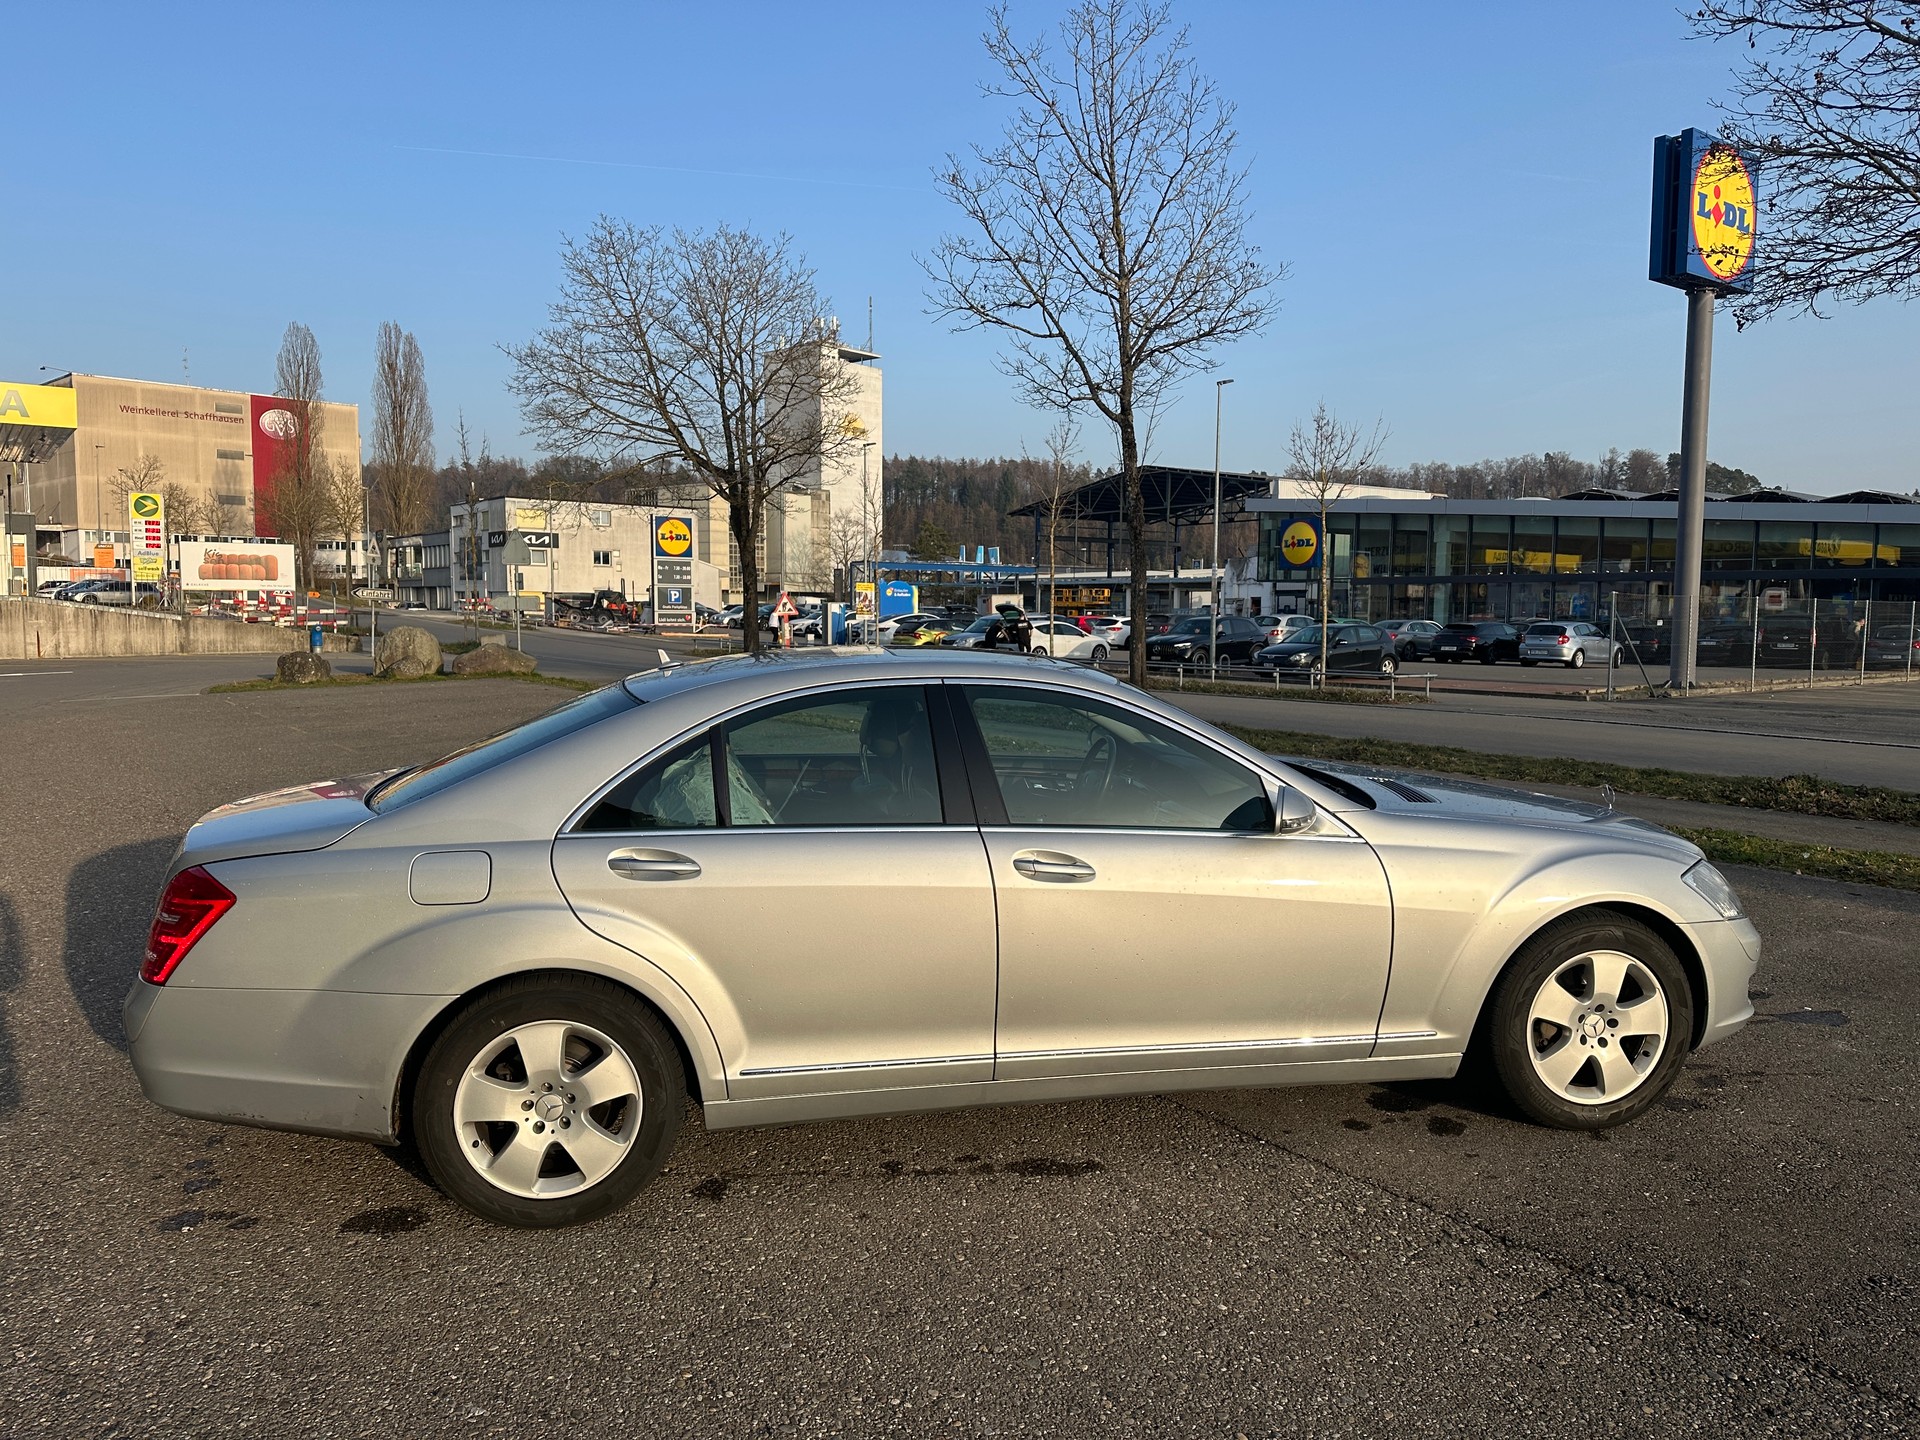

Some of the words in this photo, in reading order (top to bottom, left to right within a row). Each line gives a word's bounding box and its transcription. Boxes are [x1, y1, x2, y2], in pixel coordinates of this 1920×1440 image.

[119, 404, 179, 418] Weinkellerei
[184, 411, 245, 424] Schaffhausen
[361, 589, 392, 599] Einfahrt
[670, 590, 680, 602] P
